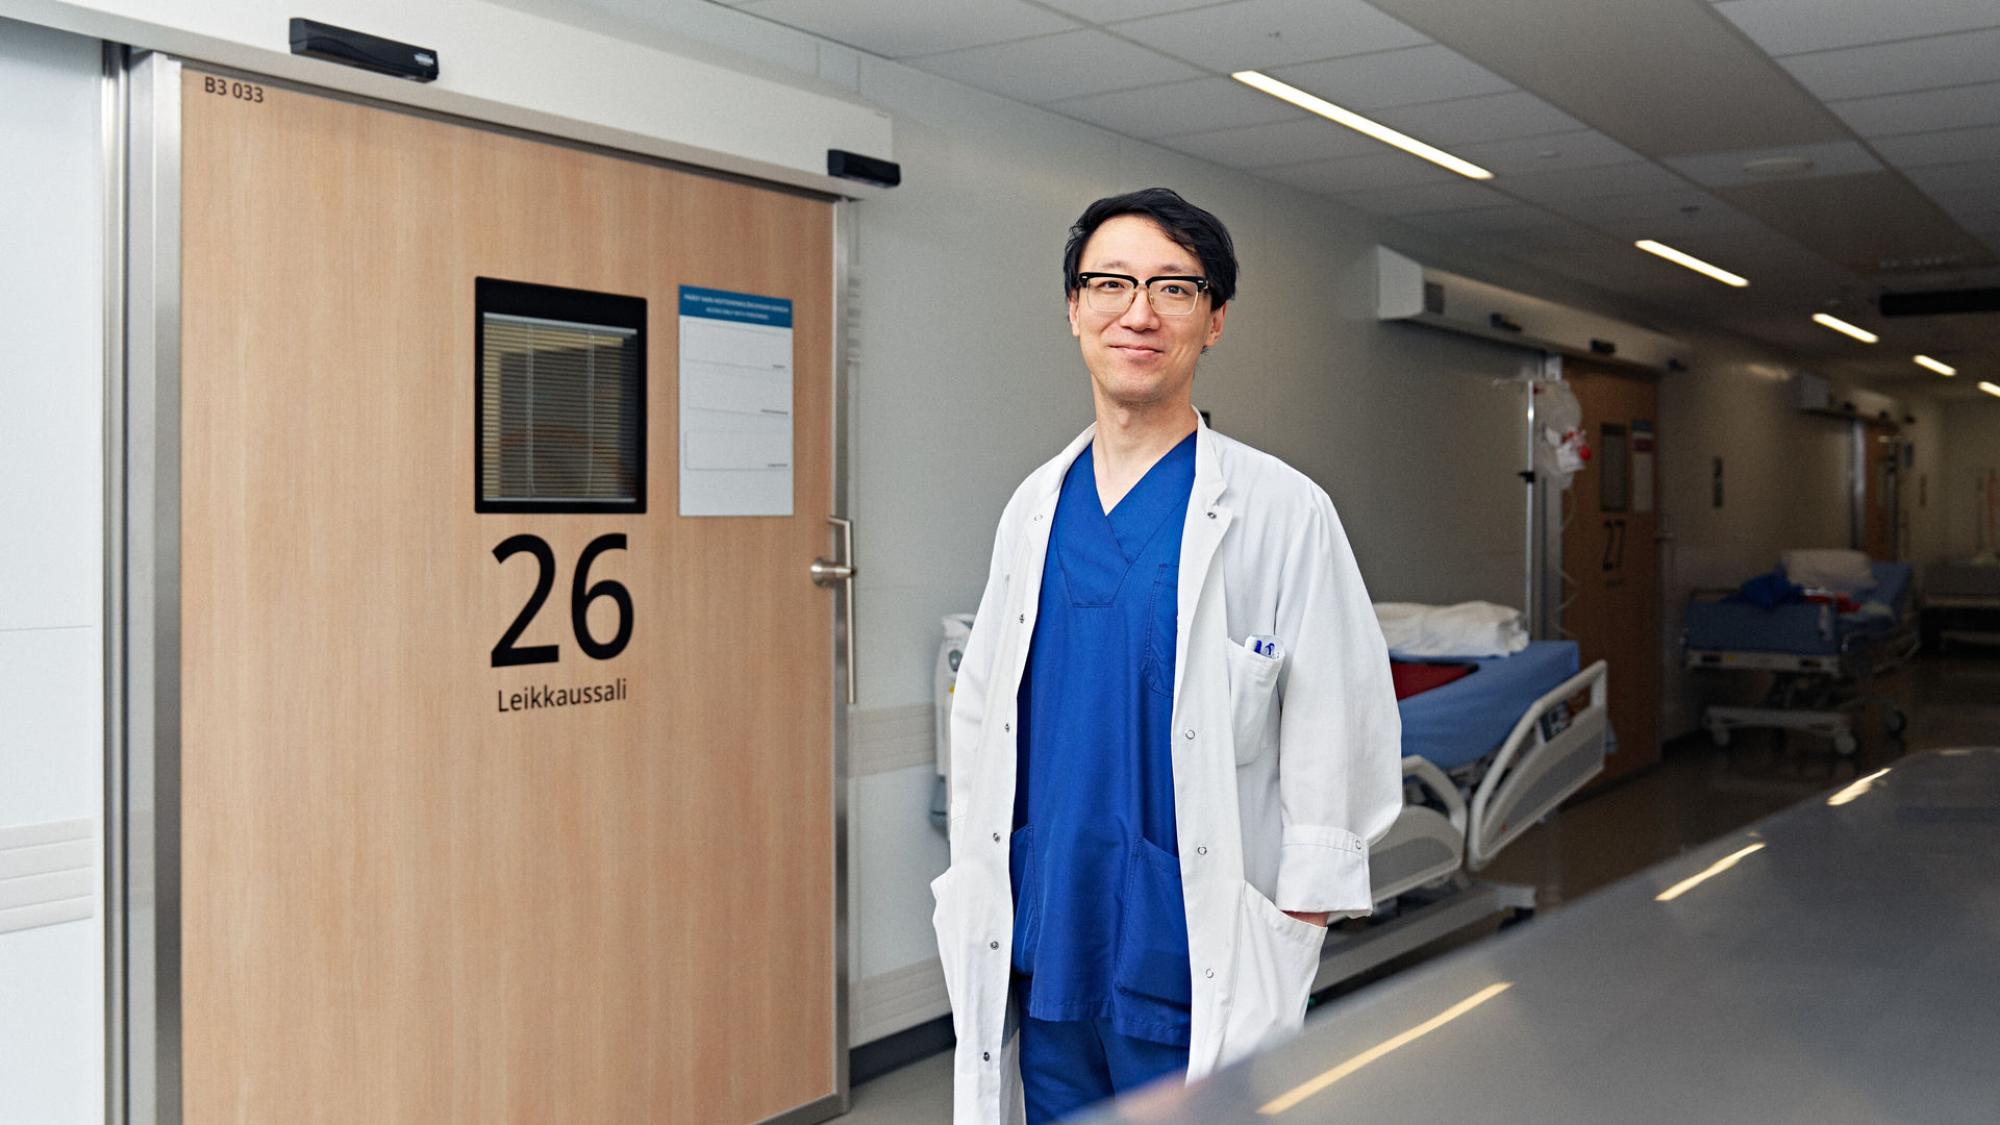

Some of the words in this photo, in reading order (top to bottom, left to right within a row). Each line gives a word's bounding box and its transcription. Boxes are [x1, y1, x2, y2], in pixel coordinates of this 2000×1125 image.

[205, 76, 227, 96] B3
[232, 82, 264, 103] 033
[1602, 520, 1627, 571] 27
[491, 532, 634, 668] 26
[498, 678, 627, 712] Leikkaussali
